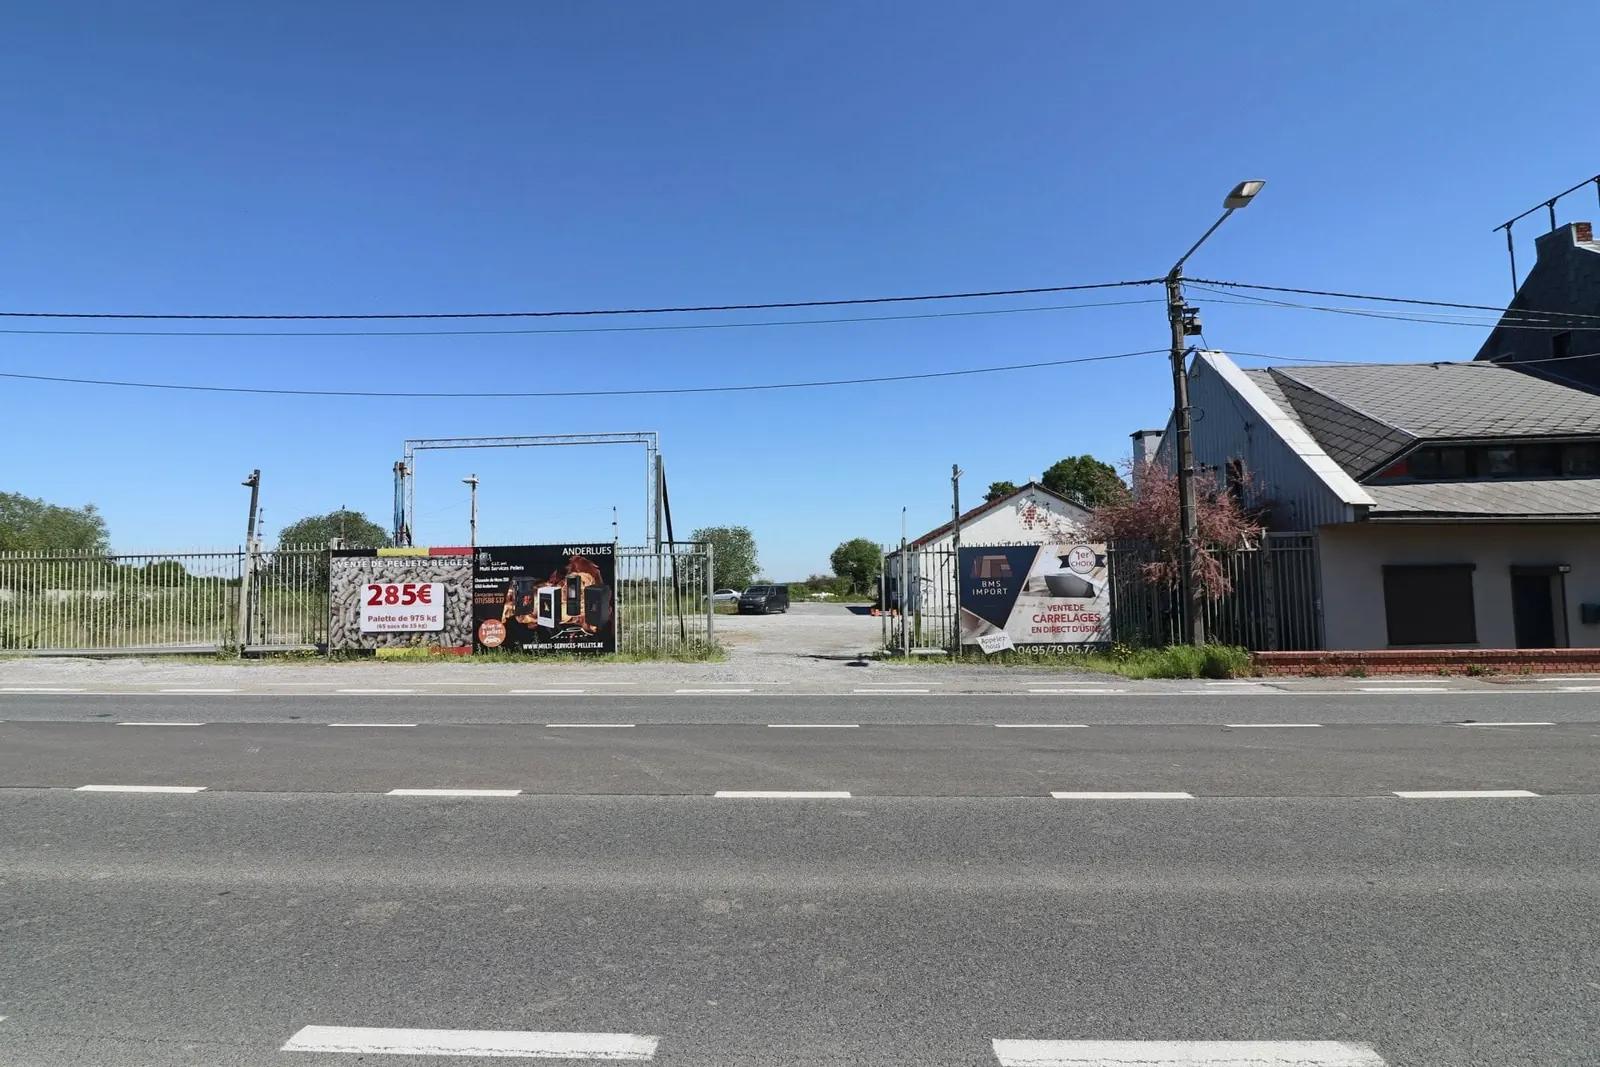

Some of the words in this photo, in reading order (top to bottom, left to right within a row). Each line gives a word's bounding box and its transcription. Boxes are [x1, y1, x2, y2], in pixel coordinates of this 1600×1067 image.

[562, 547, 612, 556] ANDERLUES
[371, 560, 383, 568] DE
[387, 560, 428, 568] PELLETS
[431, 559, 469, 567] BELGES
[367, 584, 432, 606] 285€
[1047, 604, 1072, 612] VENTE
[426, 614, 437, 623] kg
[1032, 613, 1101, 623] CARRELAGES
[1031, 626, 1042, 634] EN
[1043, 625, 1071, 633] DIRECT
[523, 642, 603, 650] WWW.MULTI-SERVICES-PELLETS.BE
